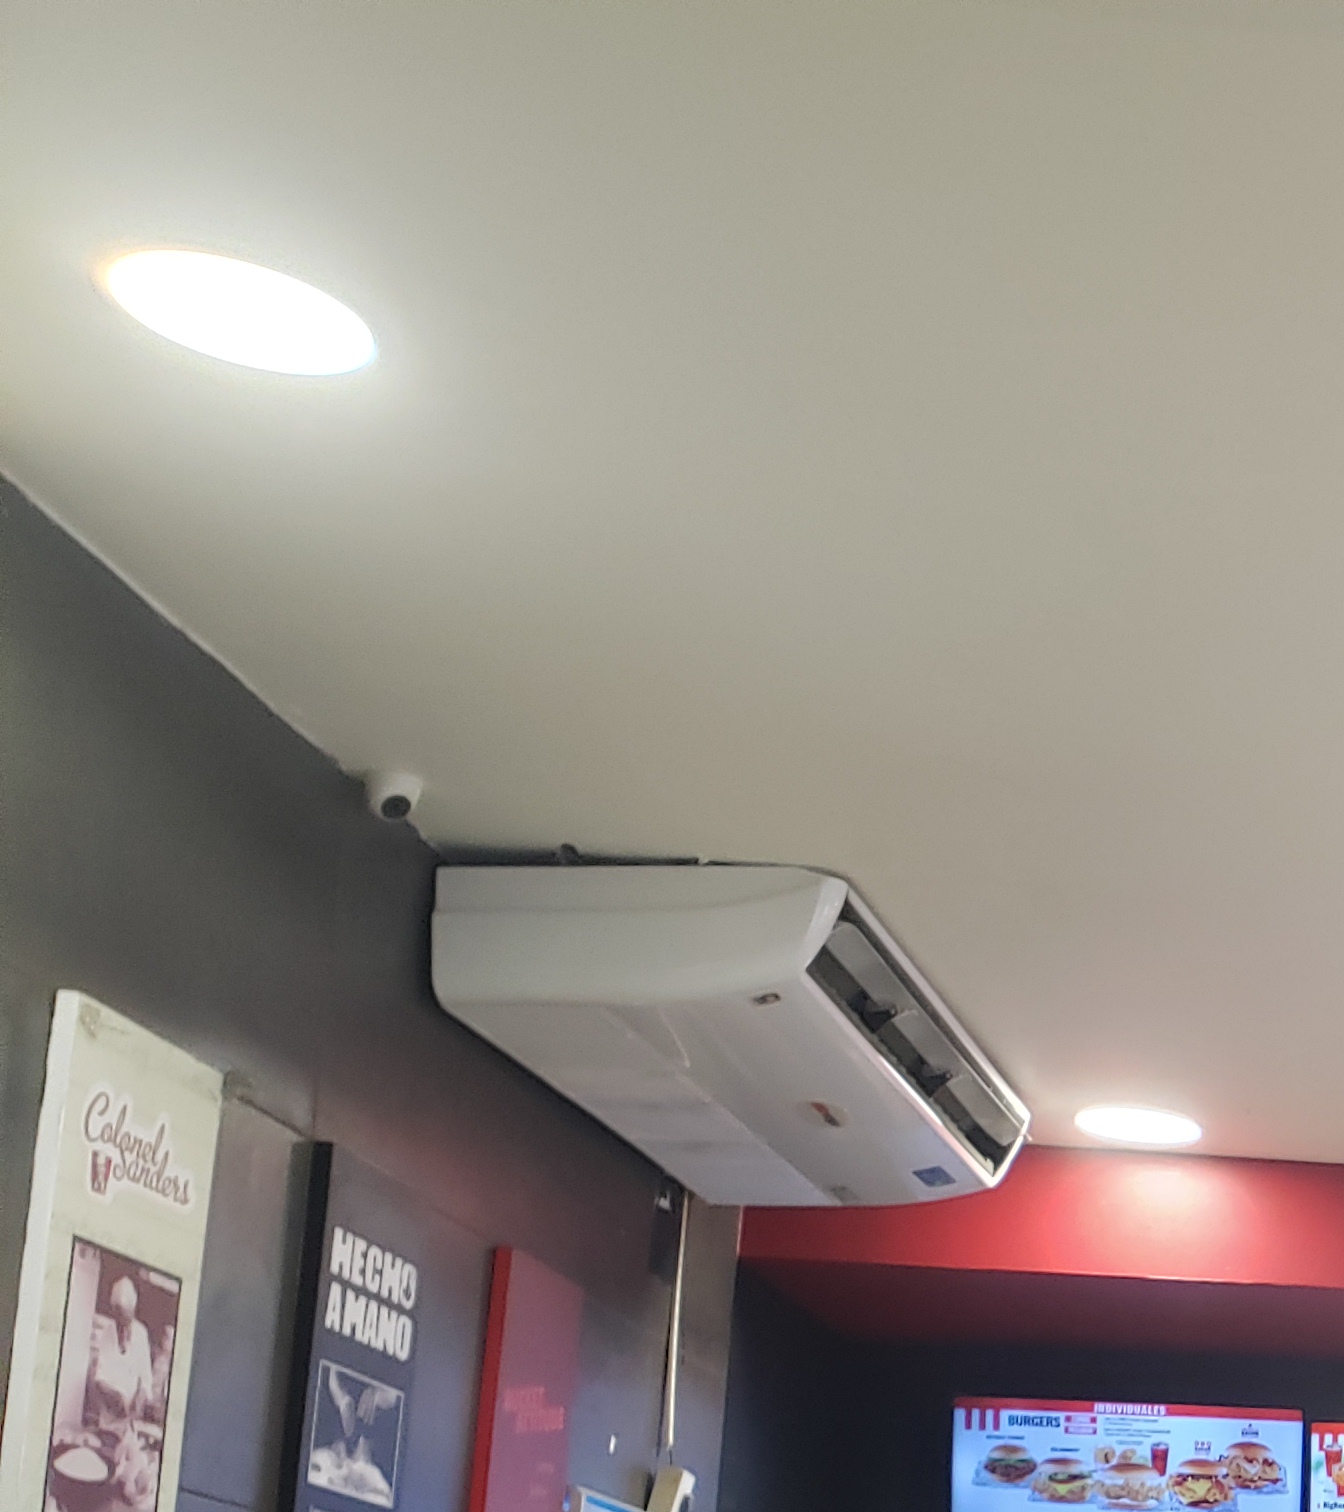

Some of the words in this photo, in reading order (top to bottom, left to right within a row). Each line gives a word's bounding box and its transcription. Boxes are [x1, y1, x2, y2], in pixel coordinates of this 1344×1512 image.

[84, 1091, 165, 1167] Colonel
[113, 1142, 190, 1205] Sanders
[330, 1226, 418, 1311] HECHO
[324, 1281, 342, 1333] A
[342, 1287, 413, 1362] MANO
[1008, 1415, 1061, 1428] BURGERS
[1094, 1403, 1166, 1416] INDIVIDUALES
